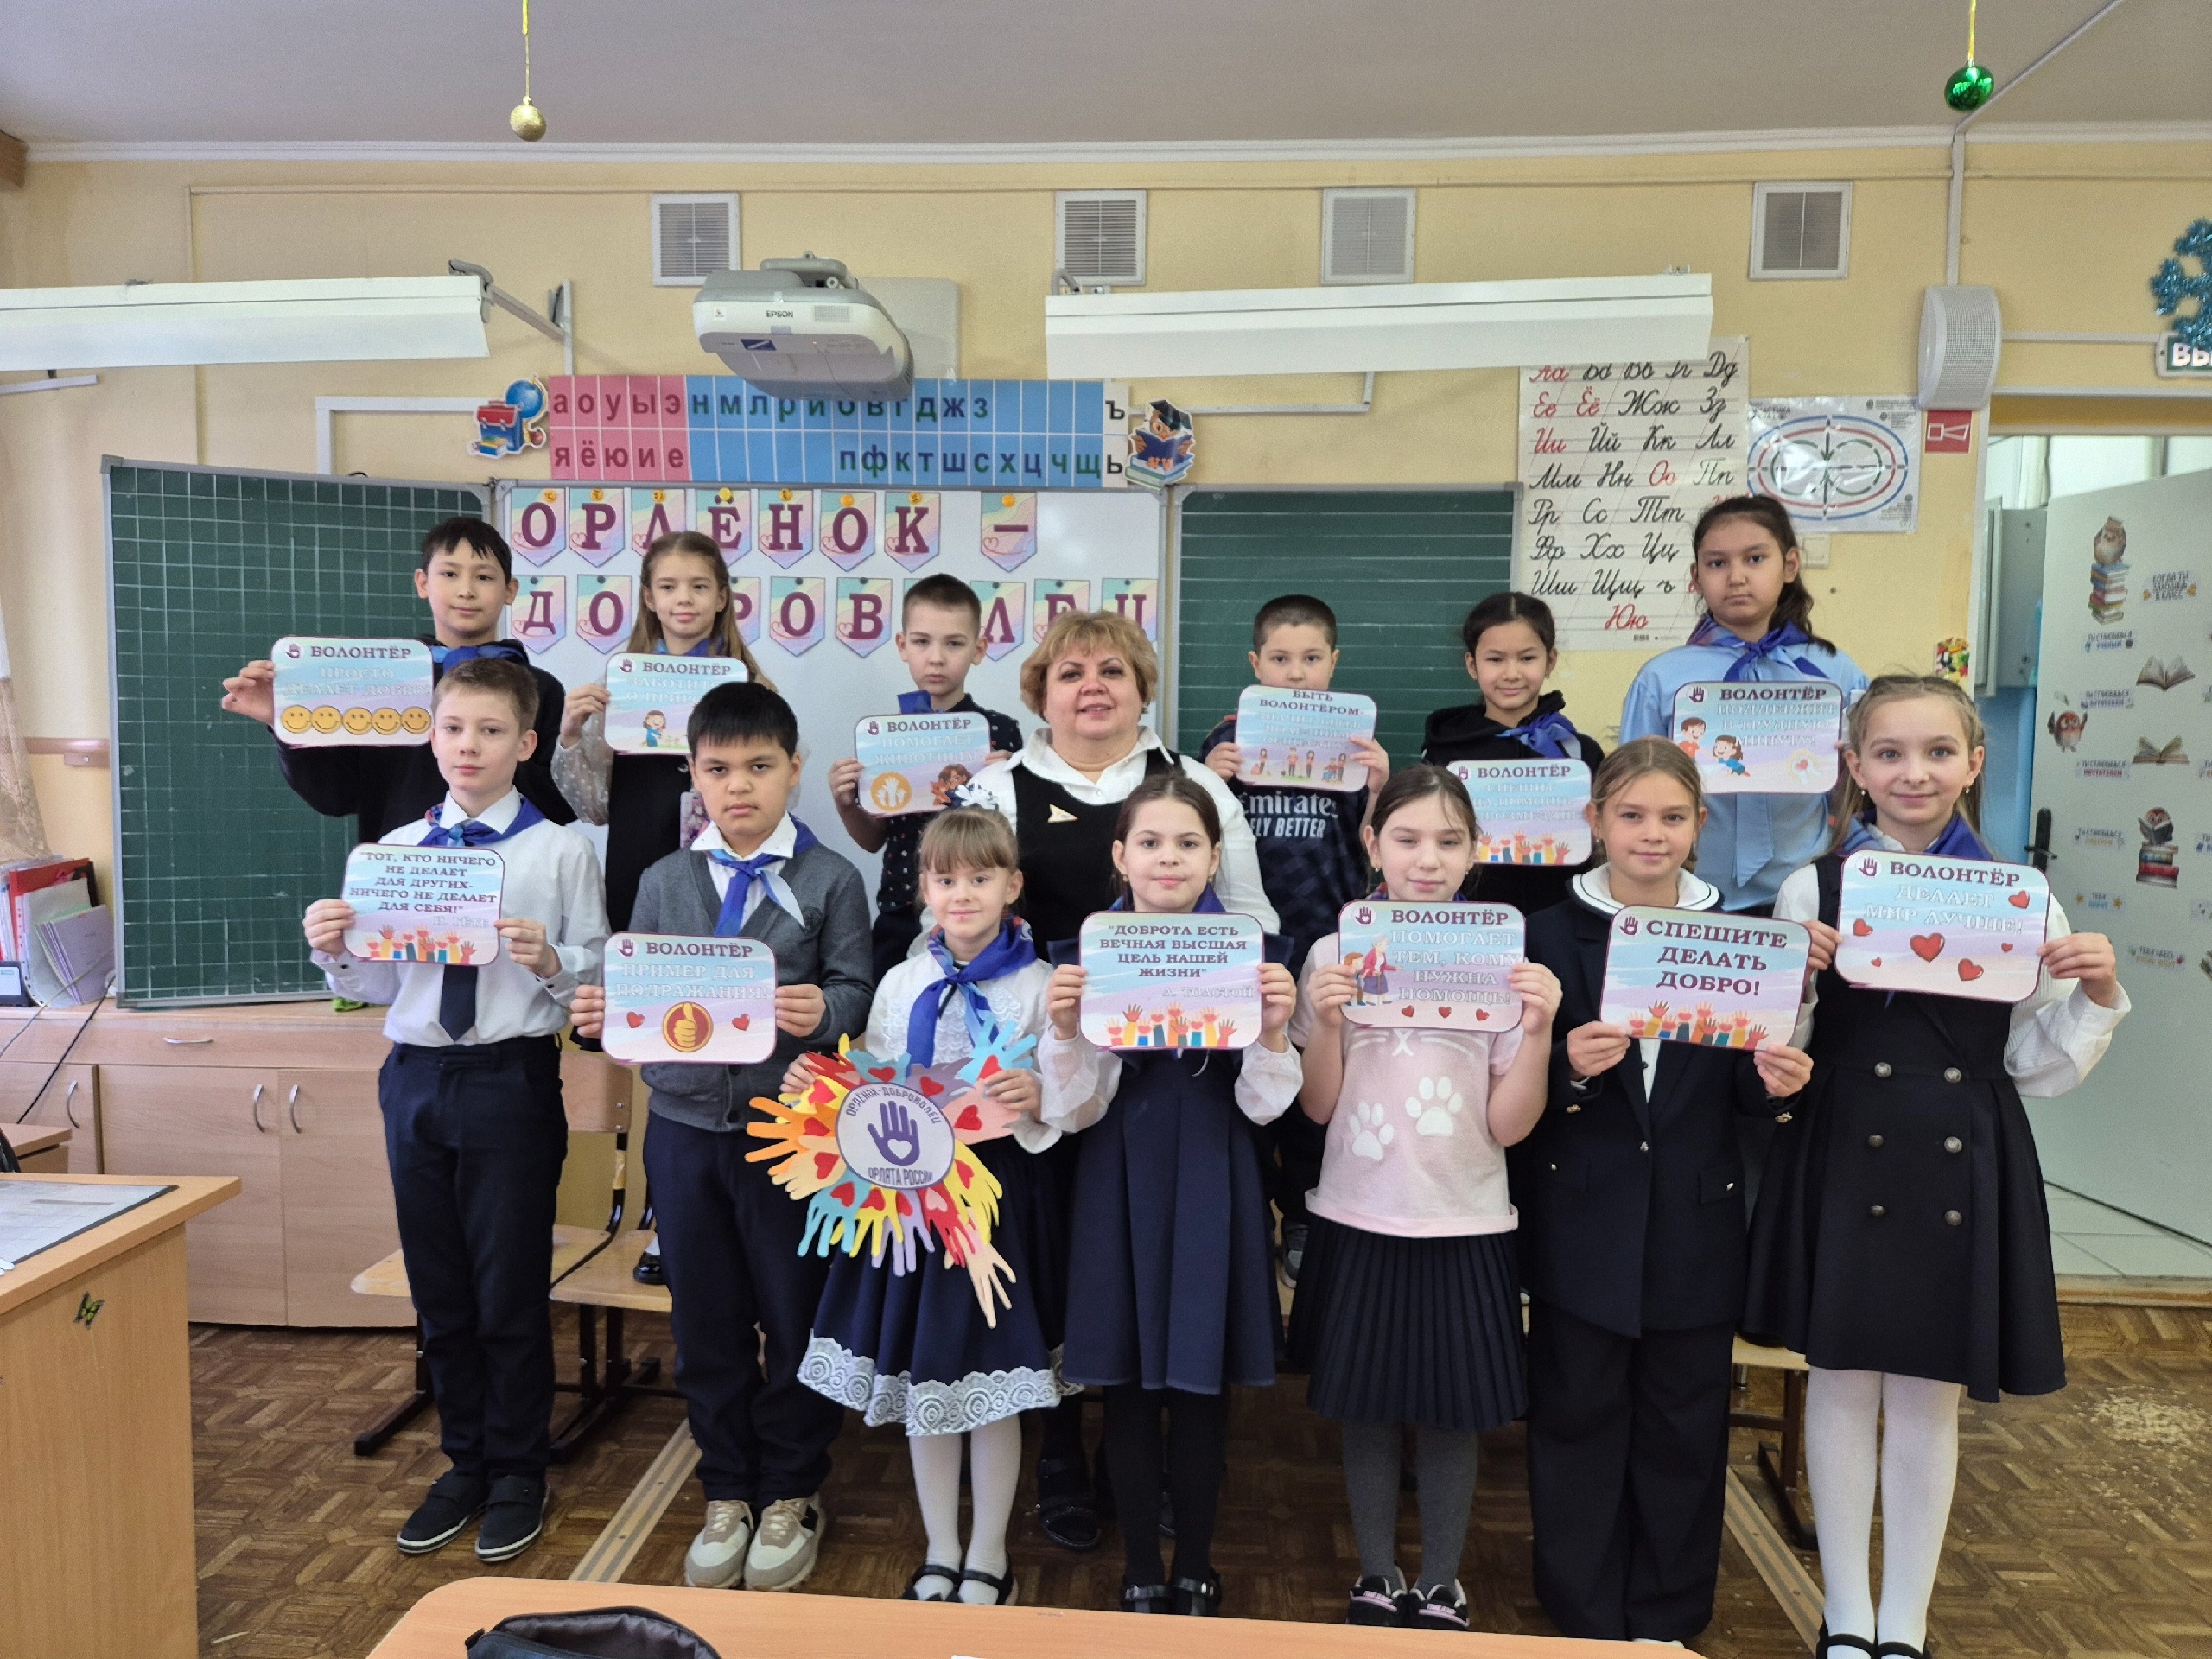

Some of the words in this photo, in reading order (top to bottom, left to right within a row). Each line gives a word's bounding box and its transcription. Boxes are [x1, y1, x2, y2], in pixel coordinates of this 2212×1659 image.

[522, 590, 1147, 645] ДООВЛЕЦ
[311, 645, 411, 659] ВОЛОНТЁР
[321, 666, 395, 679] ПРОСТО
[643, 662, 731, 676] ВОЛОНТЁР
[627, 677, 724, 690] ЗАБОТИТС
[645, 692, 699, 704] ПРИРО
[1292, 690, 1333, 702] БЫТЬ
[1719, 686, 1827, 701] ВОЛОНТЁР
[887, 717, 972, 733] ВОЛОНТЁР
[881, 735, 976, 749] ПОМОГАЕТ
[1478, 764, 1571, 779] ВОЛОНТЁР
[1275, 817, 1327, 838] BETTER
[403, 854, 431, 863] КТО
[436, 855, 496, 867] НИЧЕГО
[385, 866, 404, 874] НЕ
[409, 867, 467, 876] ДЕЛАЕТ
[1890, 861, 2020, 887] ВОЛОНТЁР
[375, 877, 406, 887] ДЛЯ
[350, 888, 409, 899] НИЧЕГО
[414, 891, 434, 900] НЕ
[437, 892, 497, 903] ДЕЛАЕТ
[1895, 884, 1995, 907] ДЕЛАЕТ
[378, 901, 410, 911] ДЛЯ
[1391, 909, 1509, 925] ВОЛОНТЁР
[1864, 903, 1917, 922] МИР
[1923, 910, 2023, 935] ЛУЧШЕ!
[1197, 926, 1239, 936] ЕСТЬ
[1391, 930, 1518, 945] ПОМОГАЕТ
[1646, 920, 1788, 949] СПЕШИТЕ
[646, 941, 753, 957] ВОЛОНТЁР
[1100, 939, 1166, 950] ВЕЧНАЯ
[1171, 940, 1247, 950] ВЫСШАЯ
[1118, 954, 1161, 964] ЦЕЛЬ
[1166, 951, 1228, 963] НАШЕЙ
[1393, 950, 1446, 967] ТЕМ,
[1453, 952, 1521, 966] КОМУ
[1657, 946, 1767, 971] ДЕЛАТЬ
[623, 963, 707, 977] ПРИМЕР
[713, 966, 755, 979] ДЛЯ
[1414, 969, 1498, 985] НУЖНА
[616, 983, 769, 999] ПОДРАЖАНИЯ!
[1656, 971, 1761, 996] ДОБРО!
[1180, 984, 1254, 999] ТОЛСТОЙ
[1399, 987, 1511, 1006] ПОМОЩЬ!
[868, 1167, 902, 1186] ОРЛЯТА
[903, 1169, 933, 1186] РОССИИ
